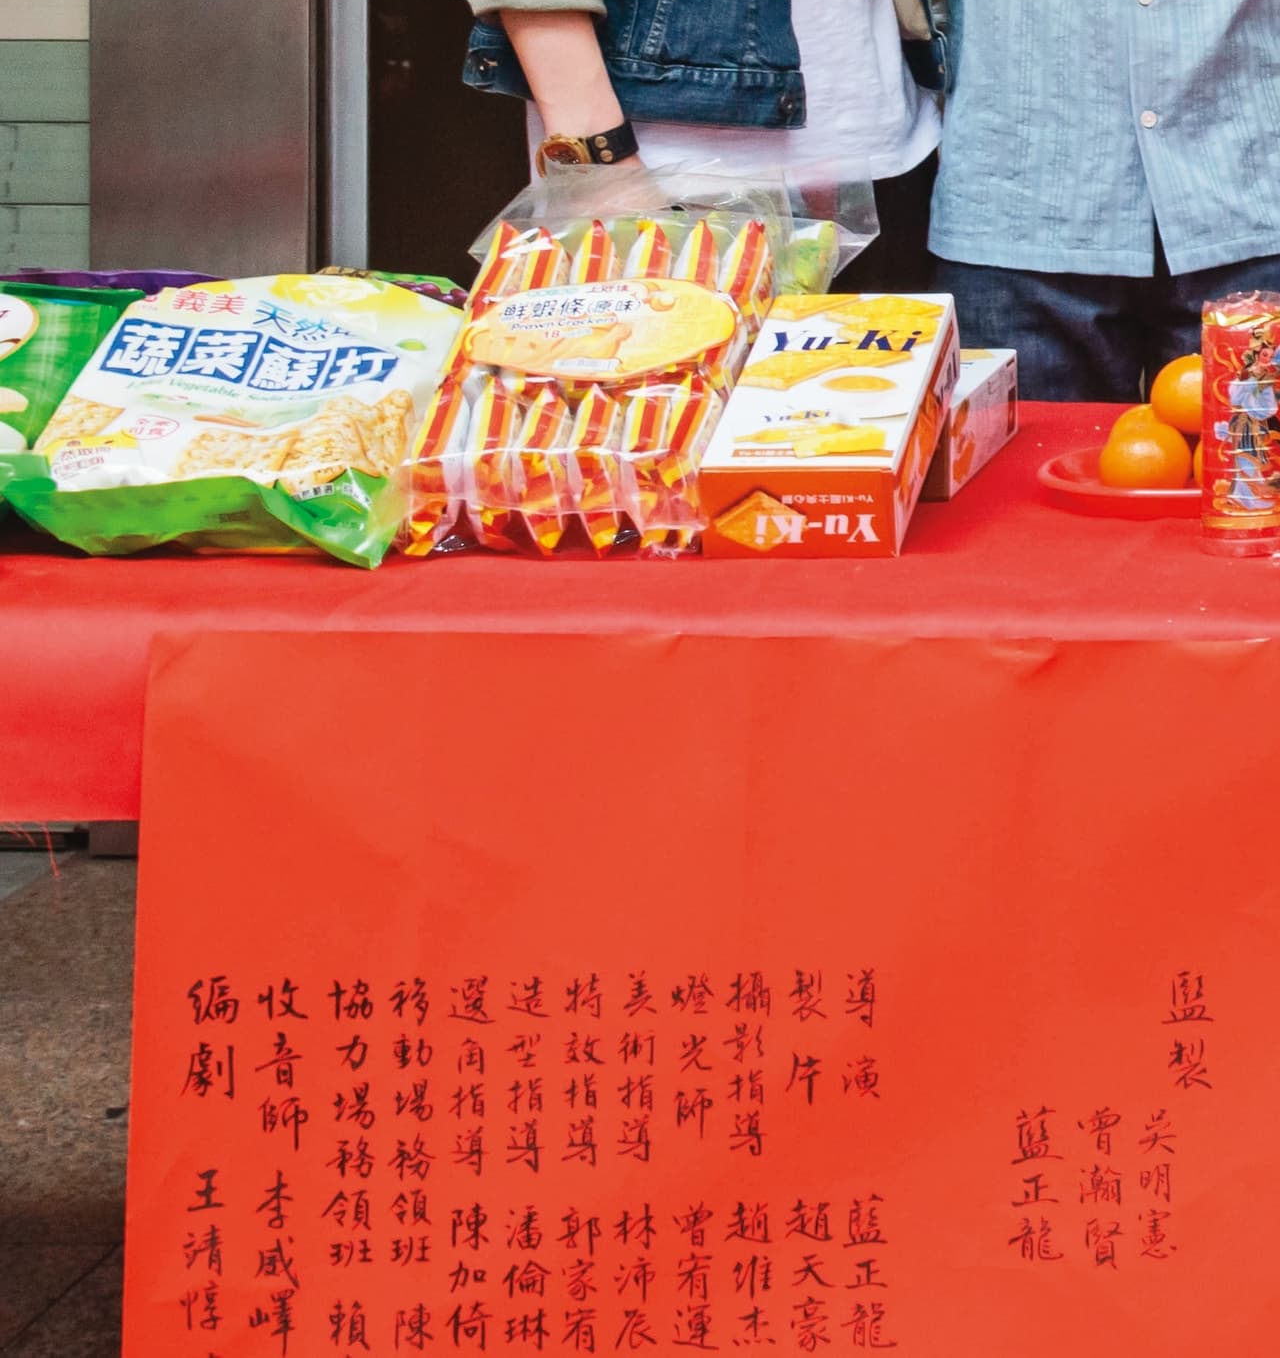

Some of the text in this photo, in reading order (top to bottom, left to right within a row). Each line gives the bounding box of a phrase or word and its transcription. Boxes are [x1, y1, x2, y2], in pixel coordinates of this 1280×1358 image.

[105, 321, 395, 390] 蔬菜蘇打
[172, 290, 248, 315] 義美
[772, 330, 922, 352] Yu-Ki
[755, 513, 881, 544] Yu-Ki
[180, 975, 240, 1100] 編劇
[255, 978, 309, 1151] 收音師
[448, 976, 494, 1176] 選角指導
[506, 977, 548, 1173] 造型指導
[562, 973, 604, 1167] 特效指導
[618, 974, 656, 1162] 美術指導
[672, 976, 714, 1138] 燈光師
[723, 972, 770, 1156] 攝影指導
[786, 970, 826, 1106] 製片
[1162, 971, 1213, 1089] 監製
[322, 978, 375, 1266] 協力場務領班
[389, 977, 435, 1264] 移動場務領班
[843, 969, 897, 1347] 導演 藍正龍
[1008, 1106, 1064, 1260] 藍正龍
